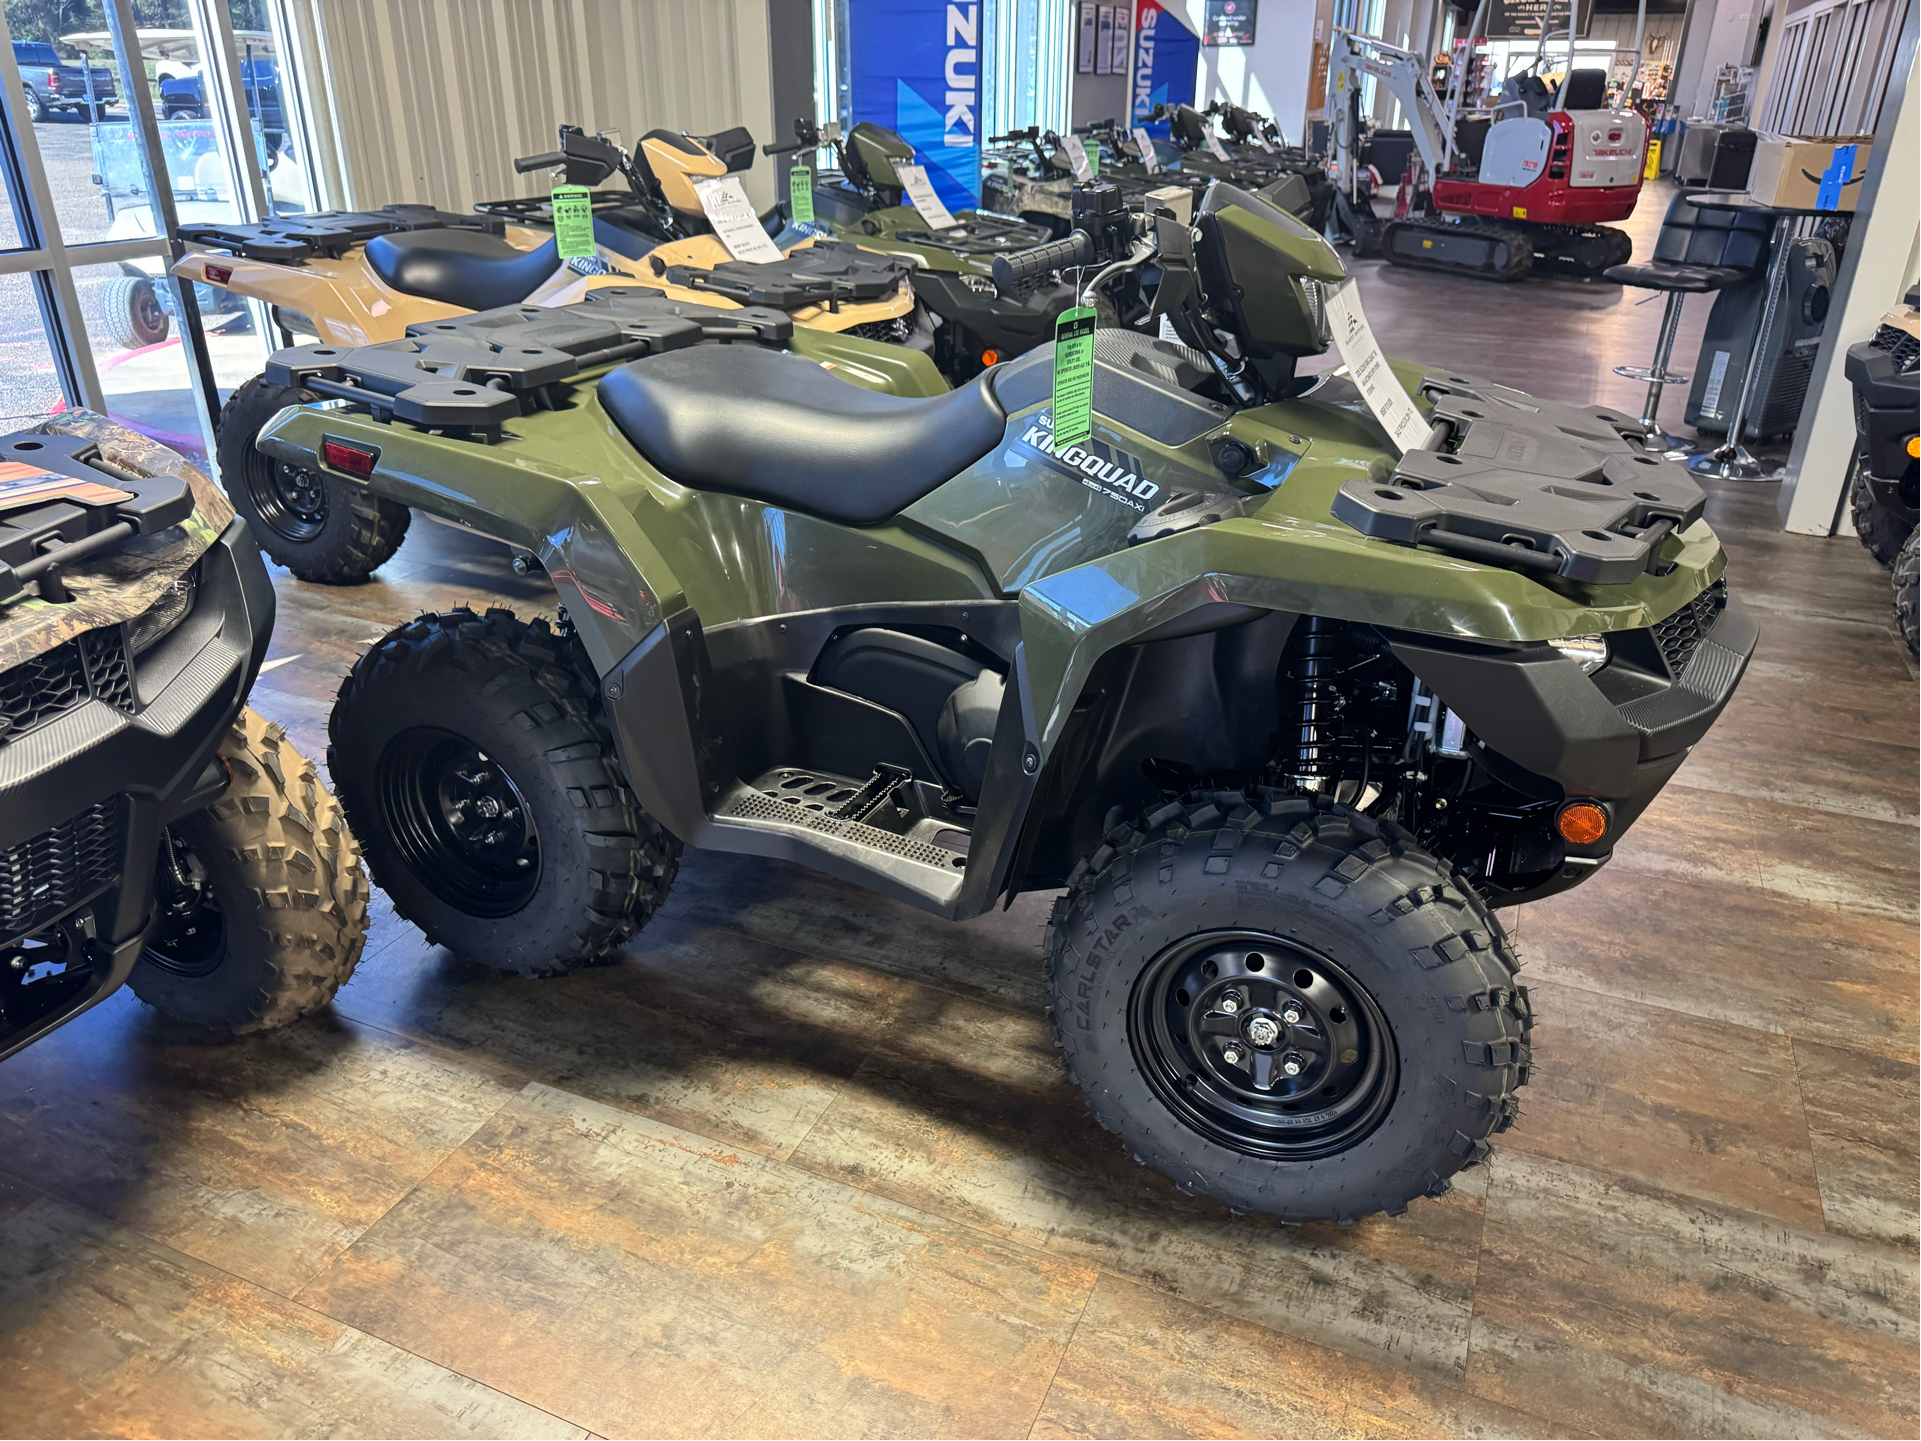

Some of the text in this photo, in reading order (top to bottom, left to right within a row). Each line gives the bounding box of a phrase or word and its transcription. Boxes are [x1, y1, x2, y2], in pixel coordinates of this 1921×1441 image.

[944, 0, 977, 147] ZUKI
[1134, 8, 1157, 116] SUZUKI
[1592, 148, 1632, 157] TAKEUCHI
[1076, 913, 1133, 1031] CARLSTAR
